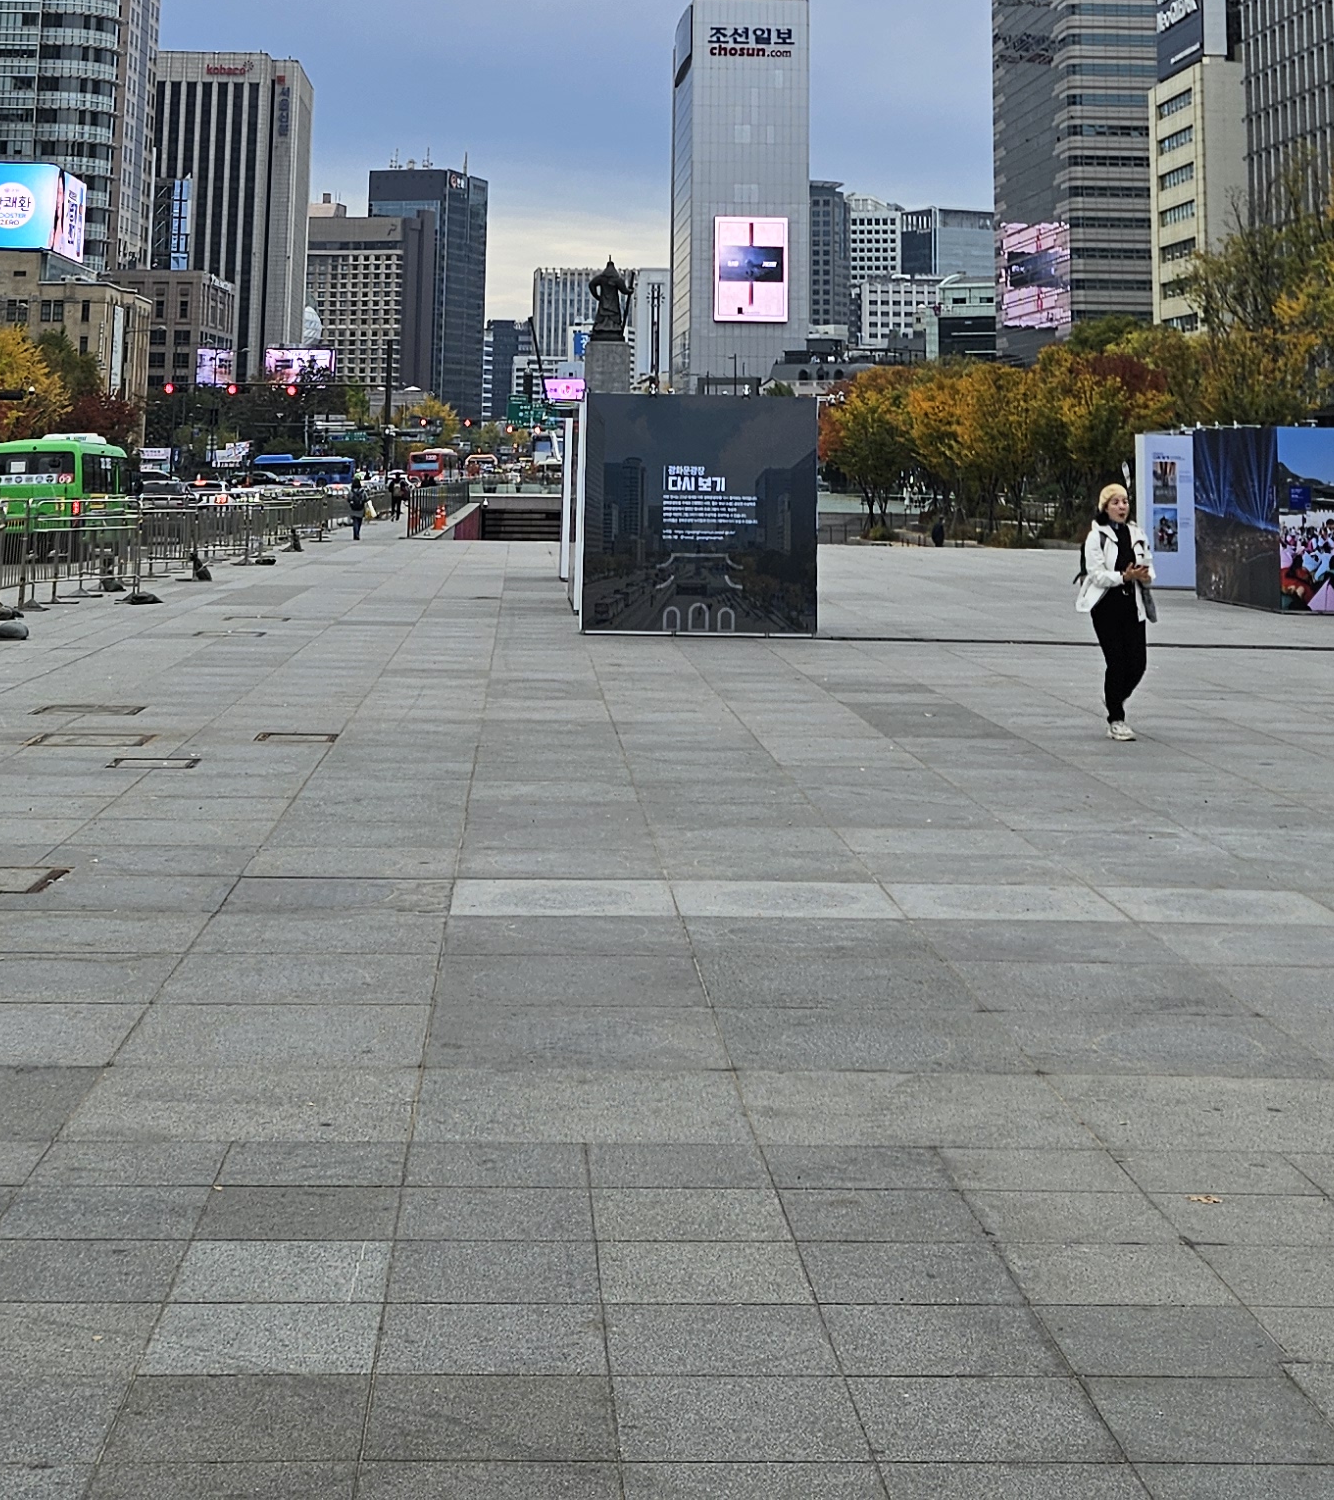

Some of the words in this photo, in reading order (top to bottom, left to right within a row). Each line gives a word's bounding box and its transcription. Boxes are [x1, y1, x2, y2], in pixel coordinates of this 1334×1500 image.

[707, 26, 795, 45] 조선일보
[709, 44, 792, 58] chosun.com
[206, 64, 246, 76] kobaco
[668, 476, 695, 491] 다시
[698, 477, 726, 492] 보기
